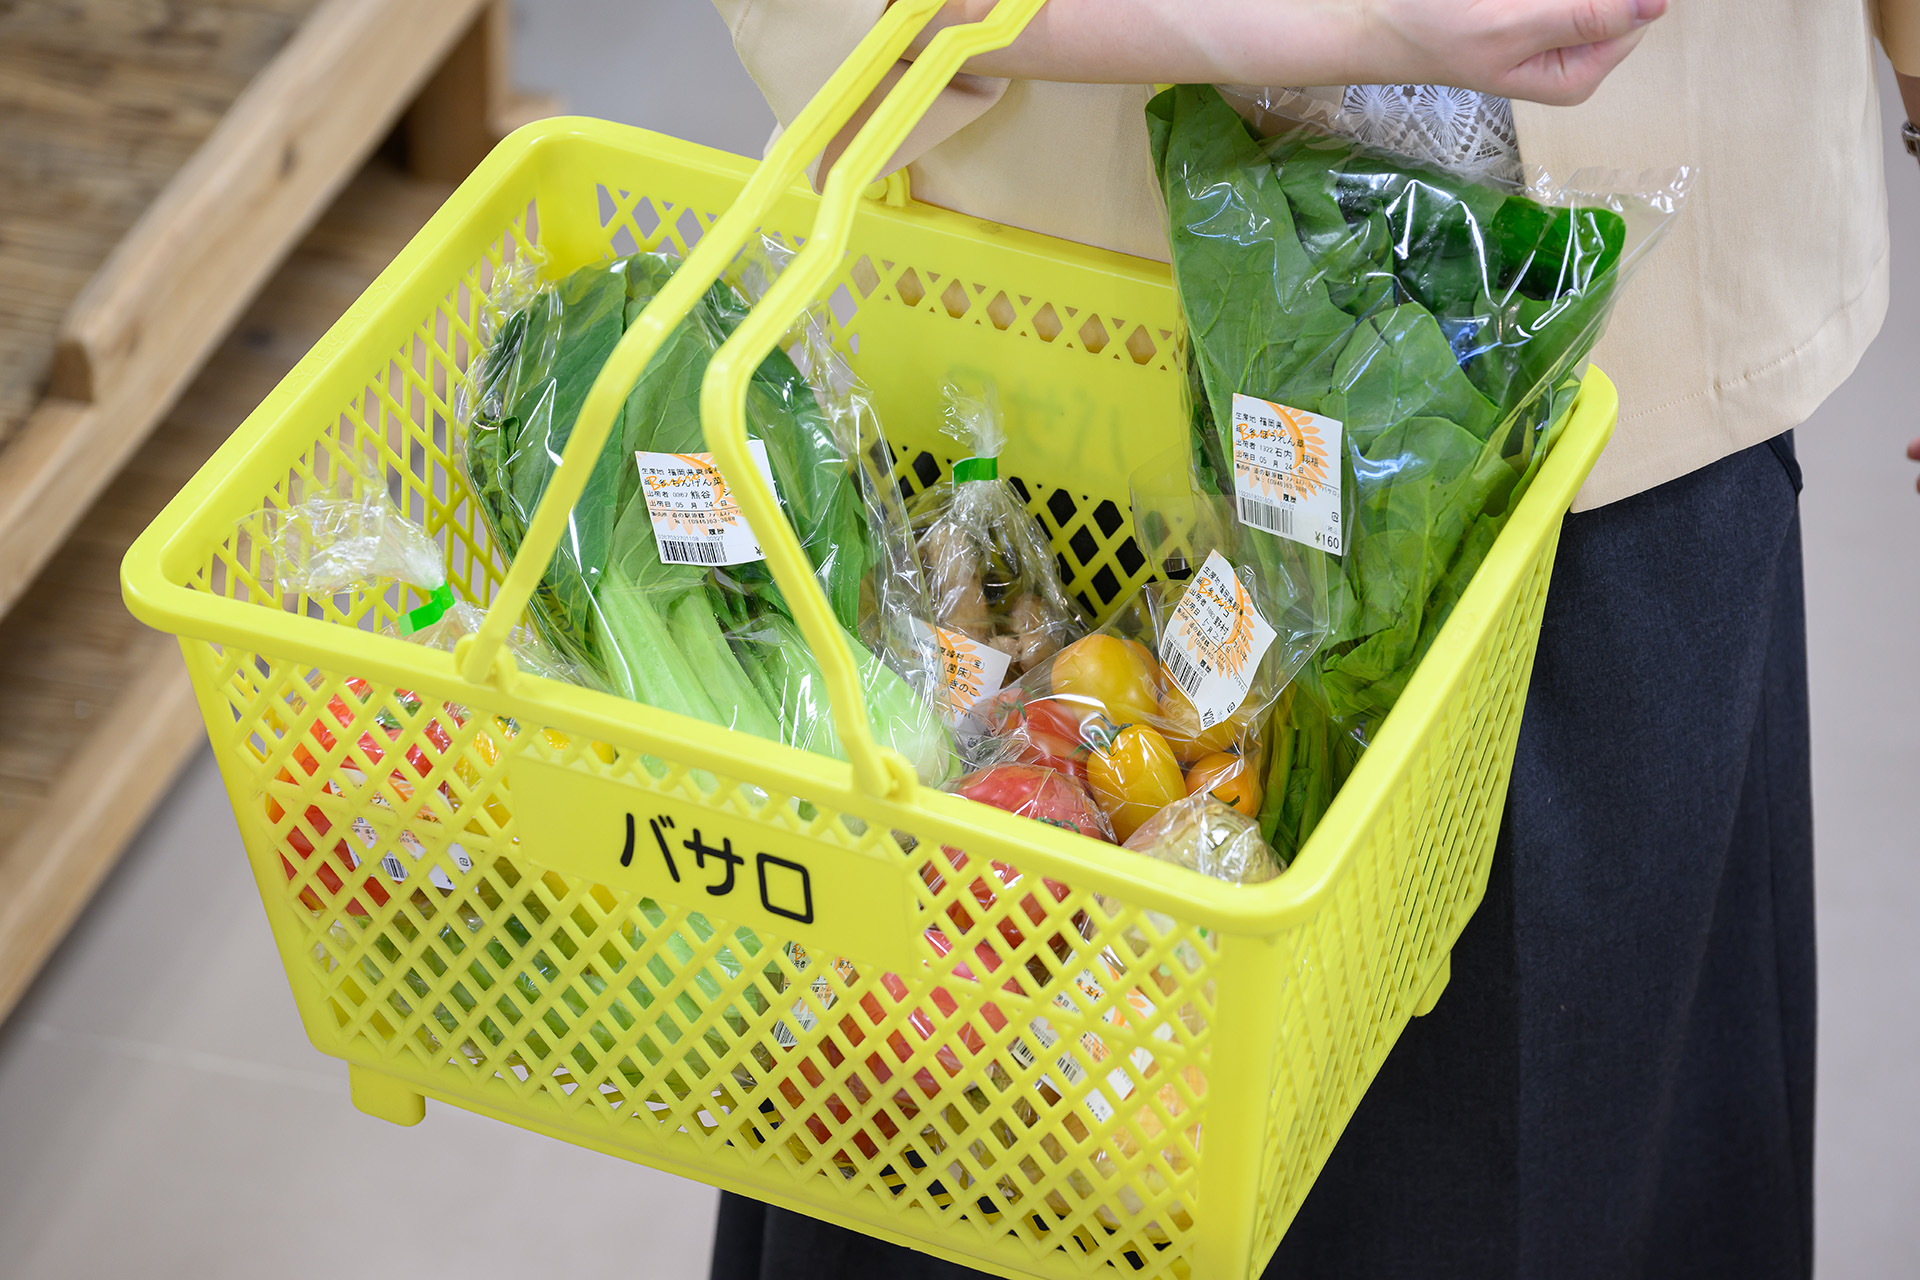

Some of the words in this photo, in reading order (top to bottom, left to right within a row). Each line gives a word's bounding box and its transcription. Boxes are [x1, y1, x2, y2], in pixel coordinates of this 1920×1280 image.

[690, 490, 711, 499] 熊谷
[1315, 531, 1340, 550] ¥160
[1213, 616, 1229, 636] 野村
[619, 812, 814, 924] バサロ
